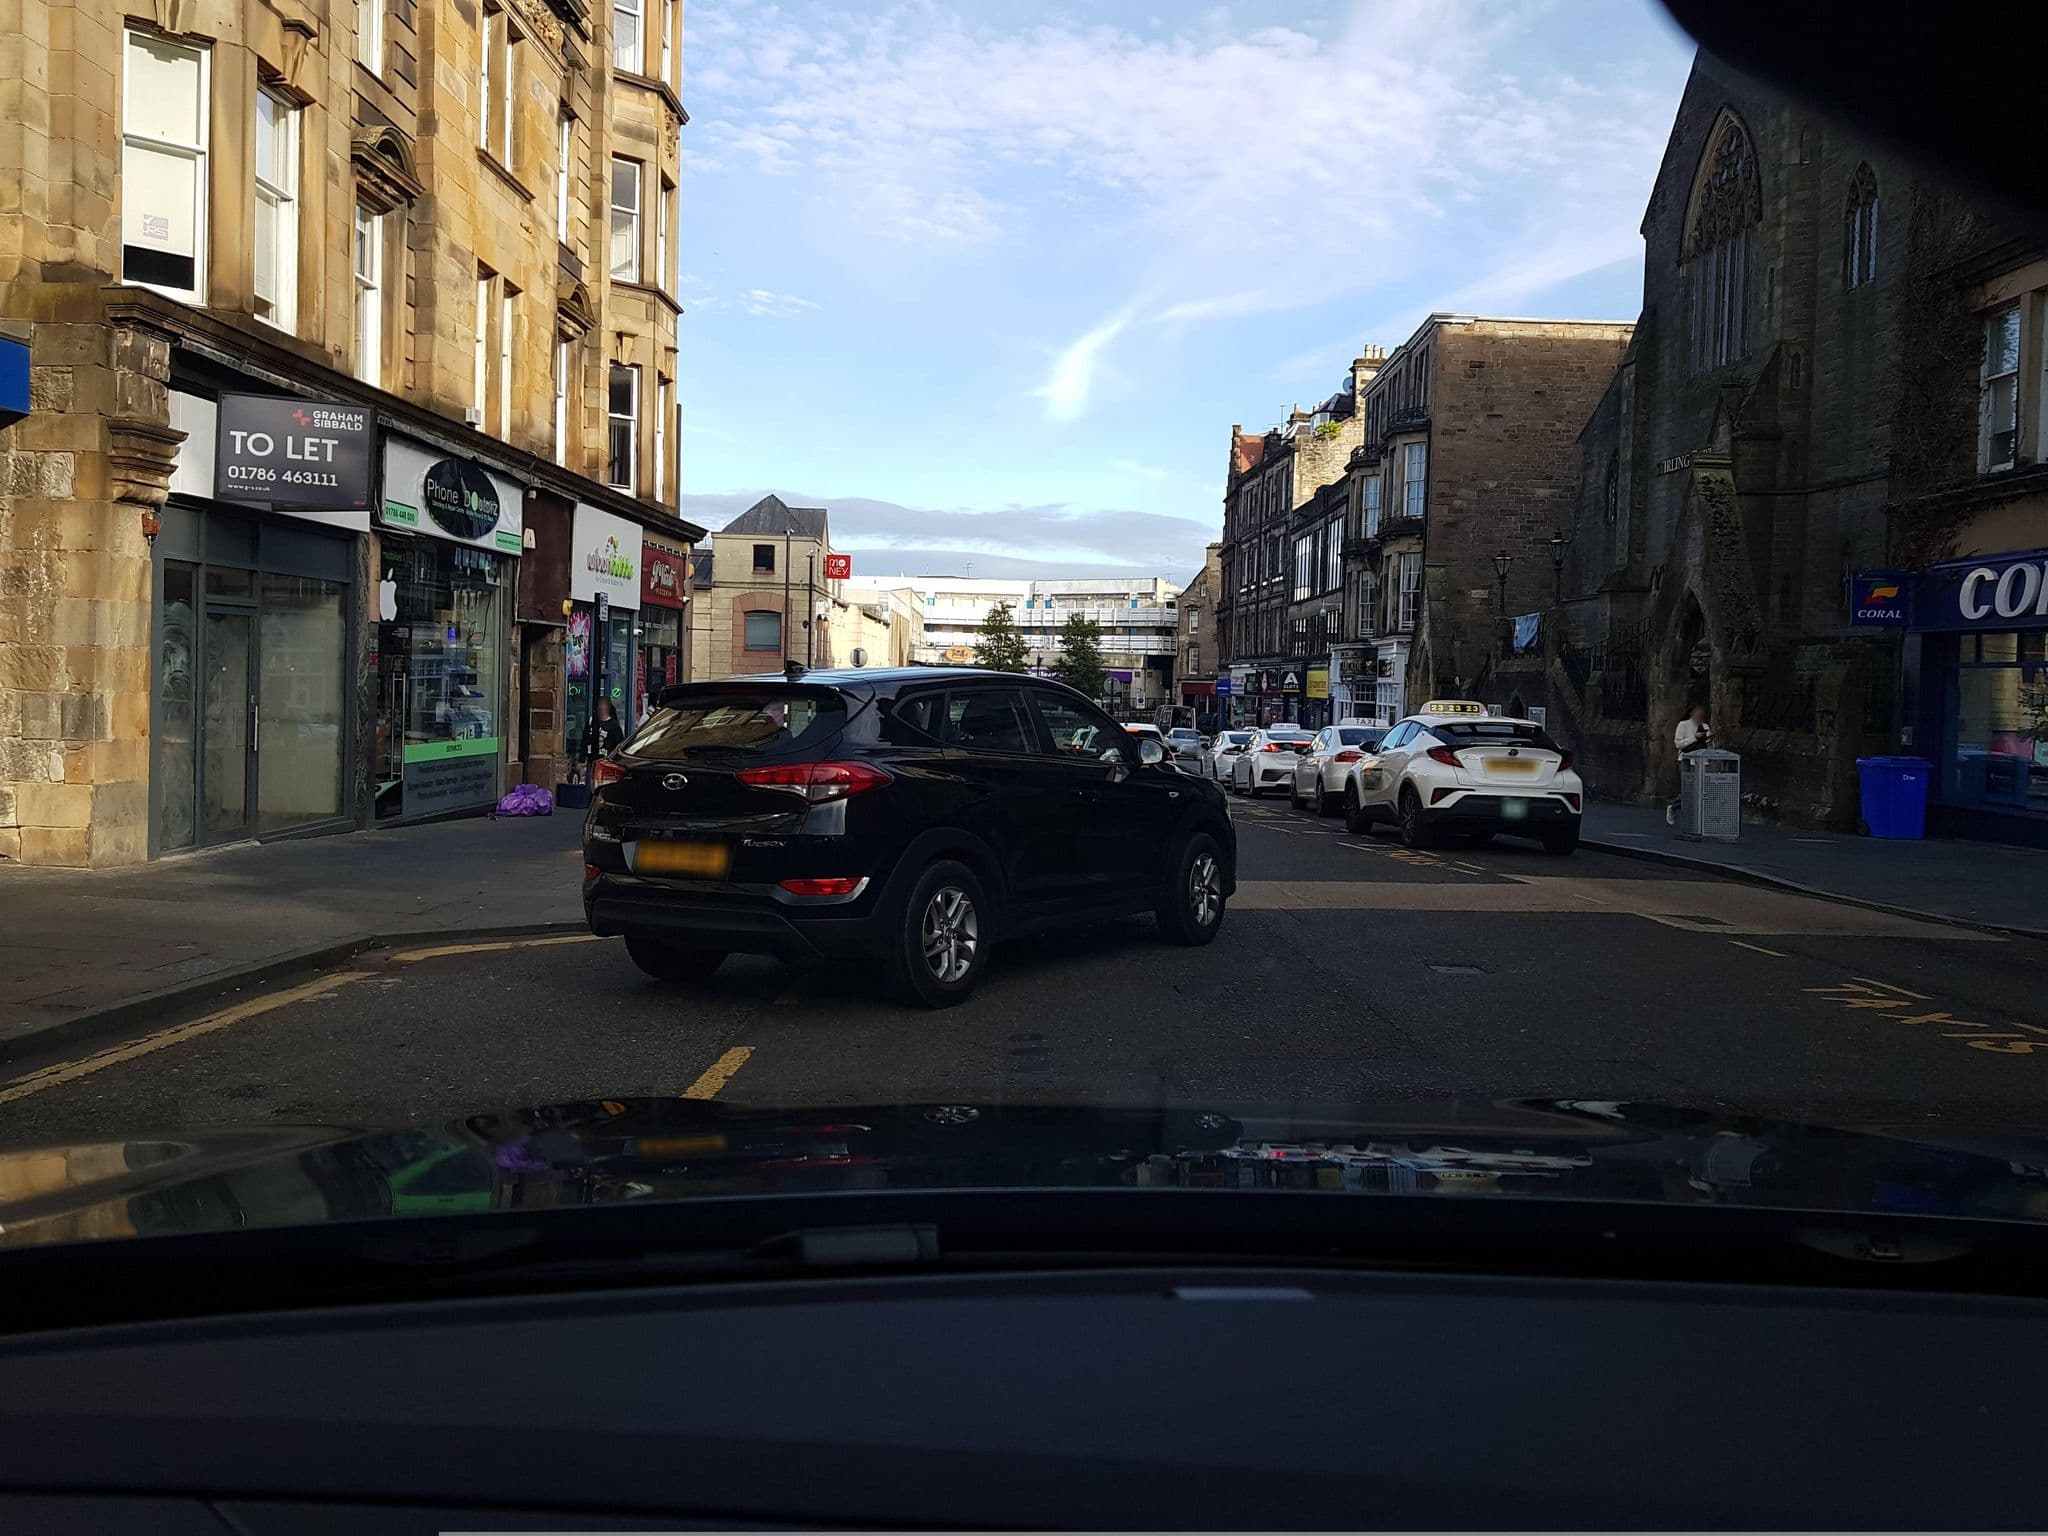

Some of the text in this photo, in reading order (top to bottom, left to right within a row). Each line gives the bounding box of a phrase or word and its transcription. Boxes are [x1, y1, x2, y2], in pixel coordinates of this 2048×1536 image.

[312, 410, 363, 423] GRAHAM
[313, 419, 363, 431] SIBBALD
[229, 430, 339, 462] TO LET
[228, 465, 338, 487] 01786 463111
[427, 478, 459, 505] Phone
[1959, 560, 2048, 620] CO
[1857, 609, 1903, 619] CORAL
[1431, 704, 1444, 712] 23
[1448, 704, 1462, 712] 23
[1354, 718, 1377, 726] TAXI
